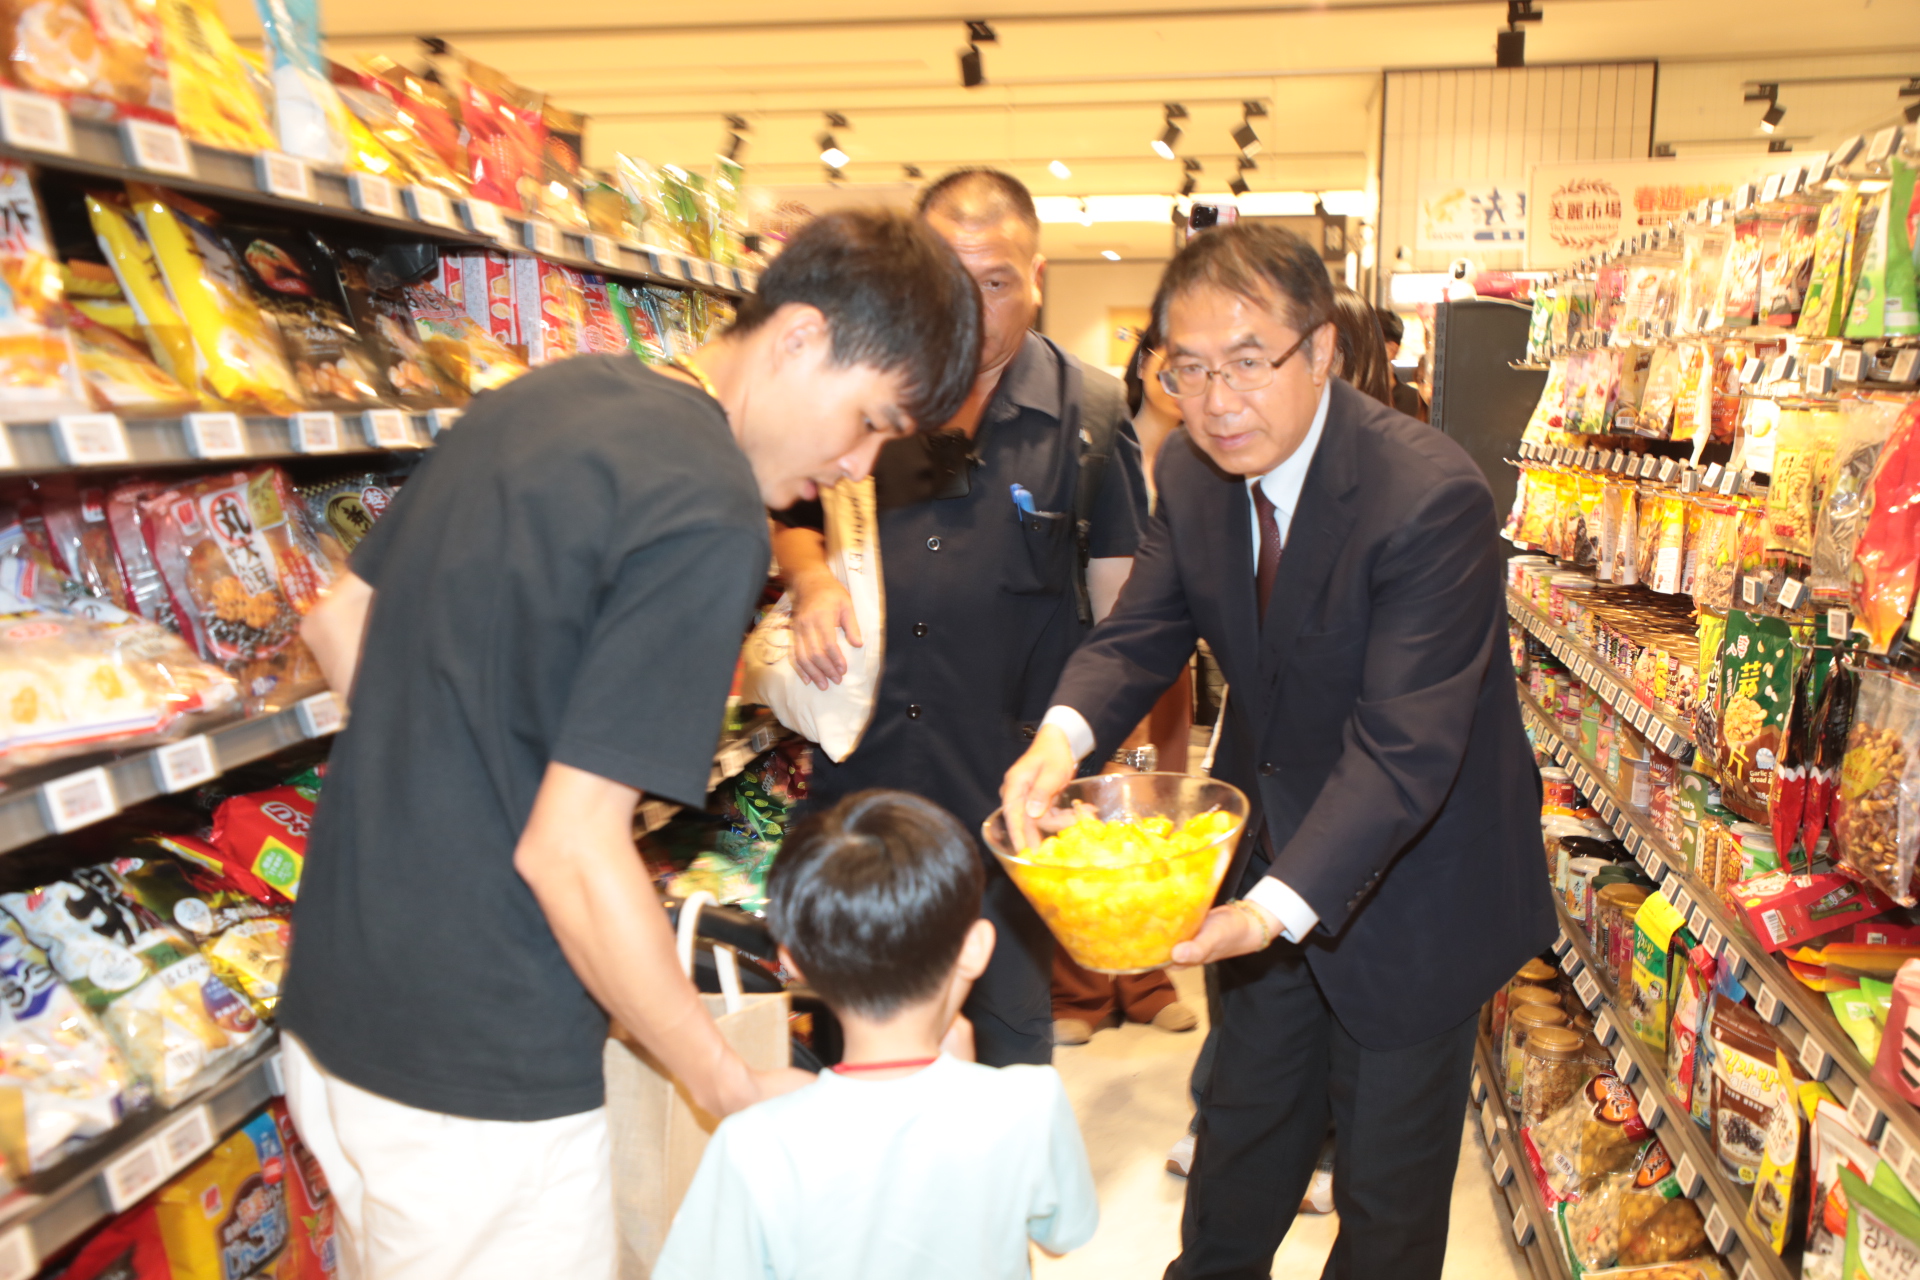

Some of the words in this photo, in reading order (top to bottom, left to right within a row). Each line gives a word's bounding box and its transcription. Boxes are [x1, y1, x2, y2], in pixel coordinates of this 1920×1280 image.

[1550, 199, 1622, 220] 美麗市場
[215, 499, 273, 590] 丸大豆
[1723, 1047, 1779, 1092] 김자반
